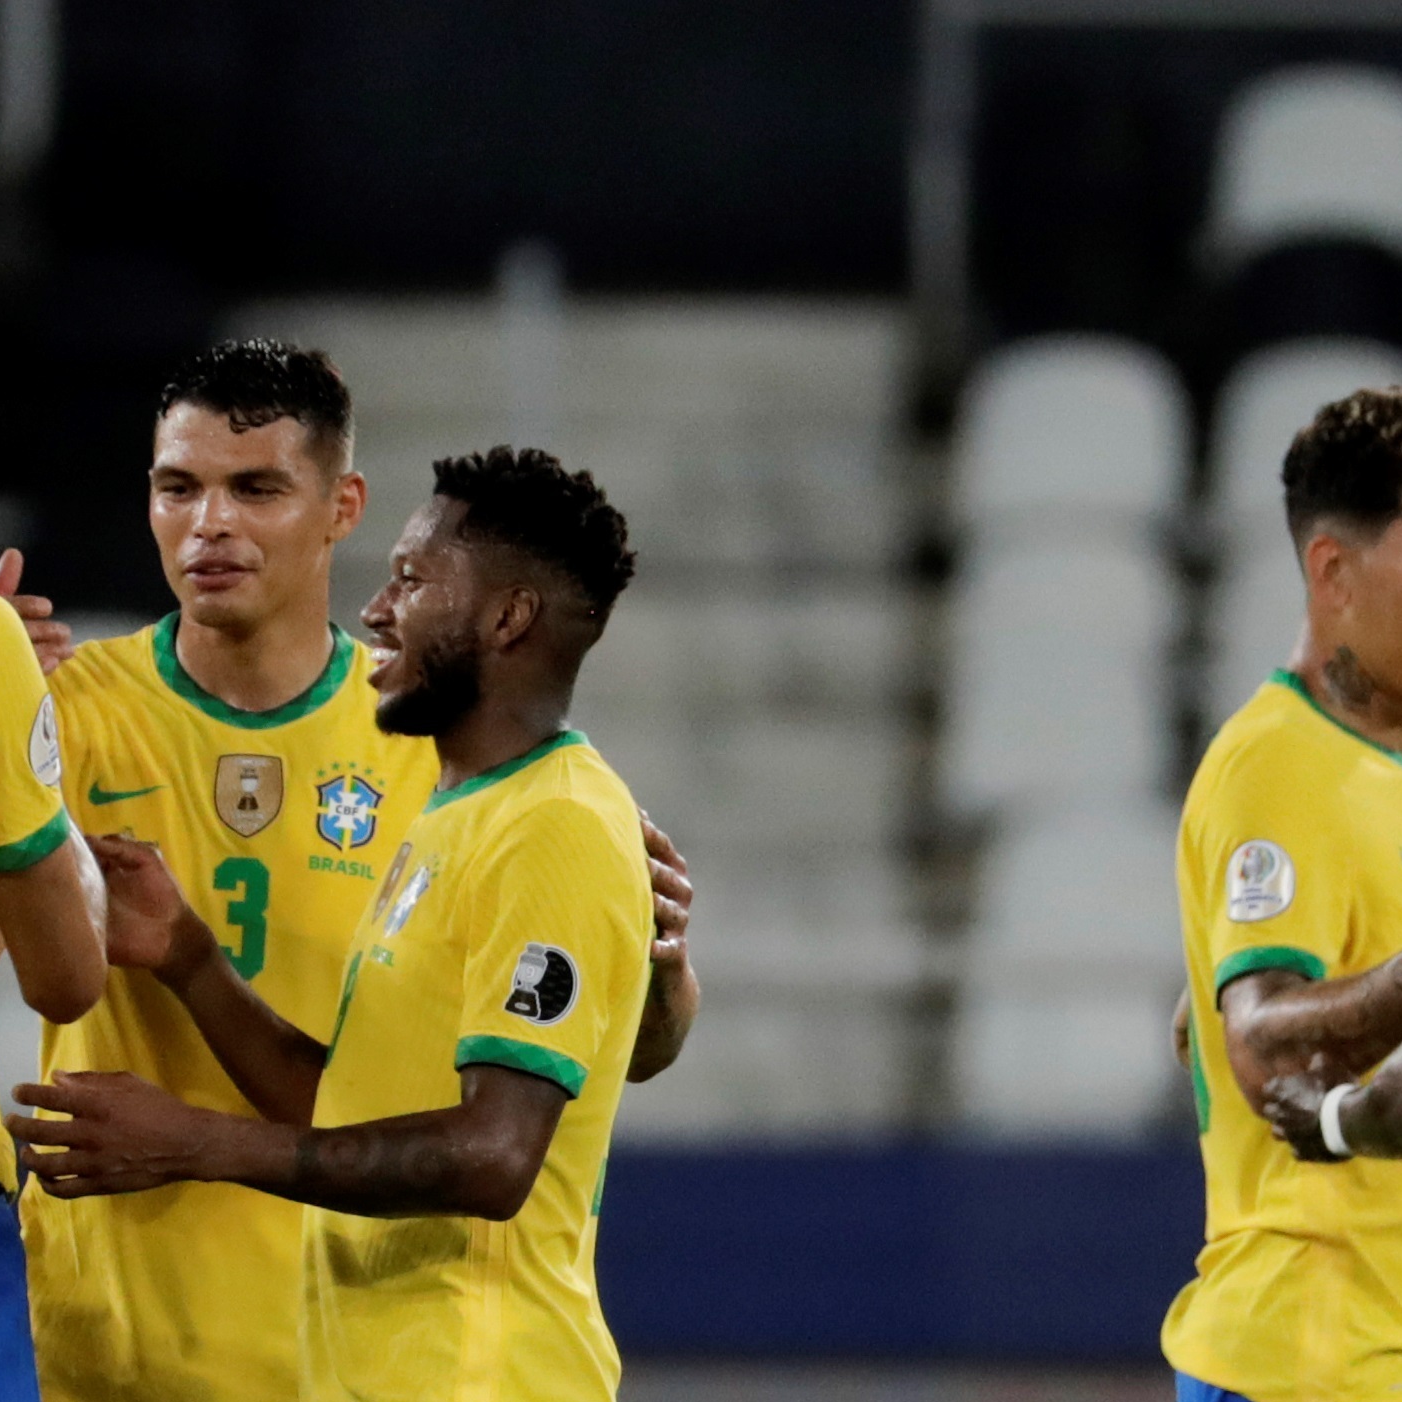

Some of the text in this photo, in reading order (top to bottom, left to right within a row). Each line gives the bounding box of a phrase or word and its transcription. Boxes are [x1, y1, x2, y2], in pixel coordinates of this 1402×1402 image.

[335, 803, 360, 817] CBF
[308, 855, 375, 880] BRASIL
[213, 857, 270, 981] 3
